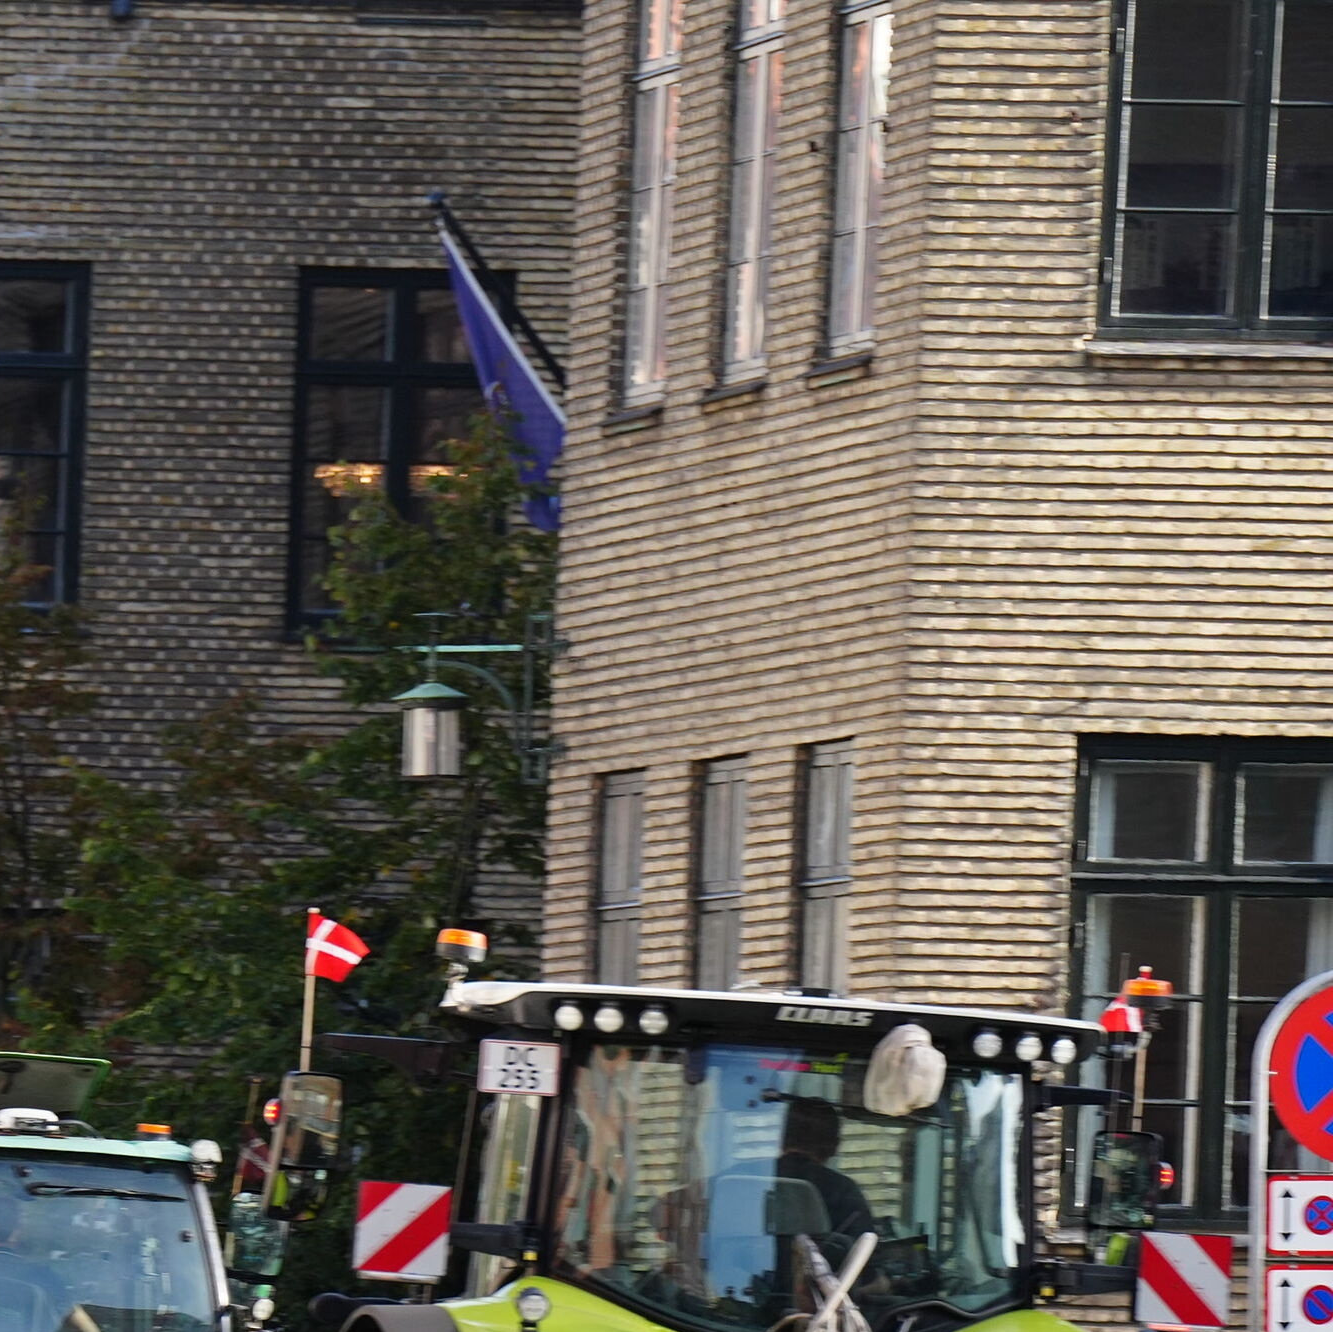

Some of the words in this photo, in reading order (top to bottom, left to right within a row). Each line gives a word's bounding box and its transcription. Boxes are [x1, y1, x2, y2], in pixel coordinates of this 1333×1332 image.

[775, 1006, 874, 1027] CLAAS
[504, 1046, 538, 1067] DC
[499, 1068, 541, 1089] 255
